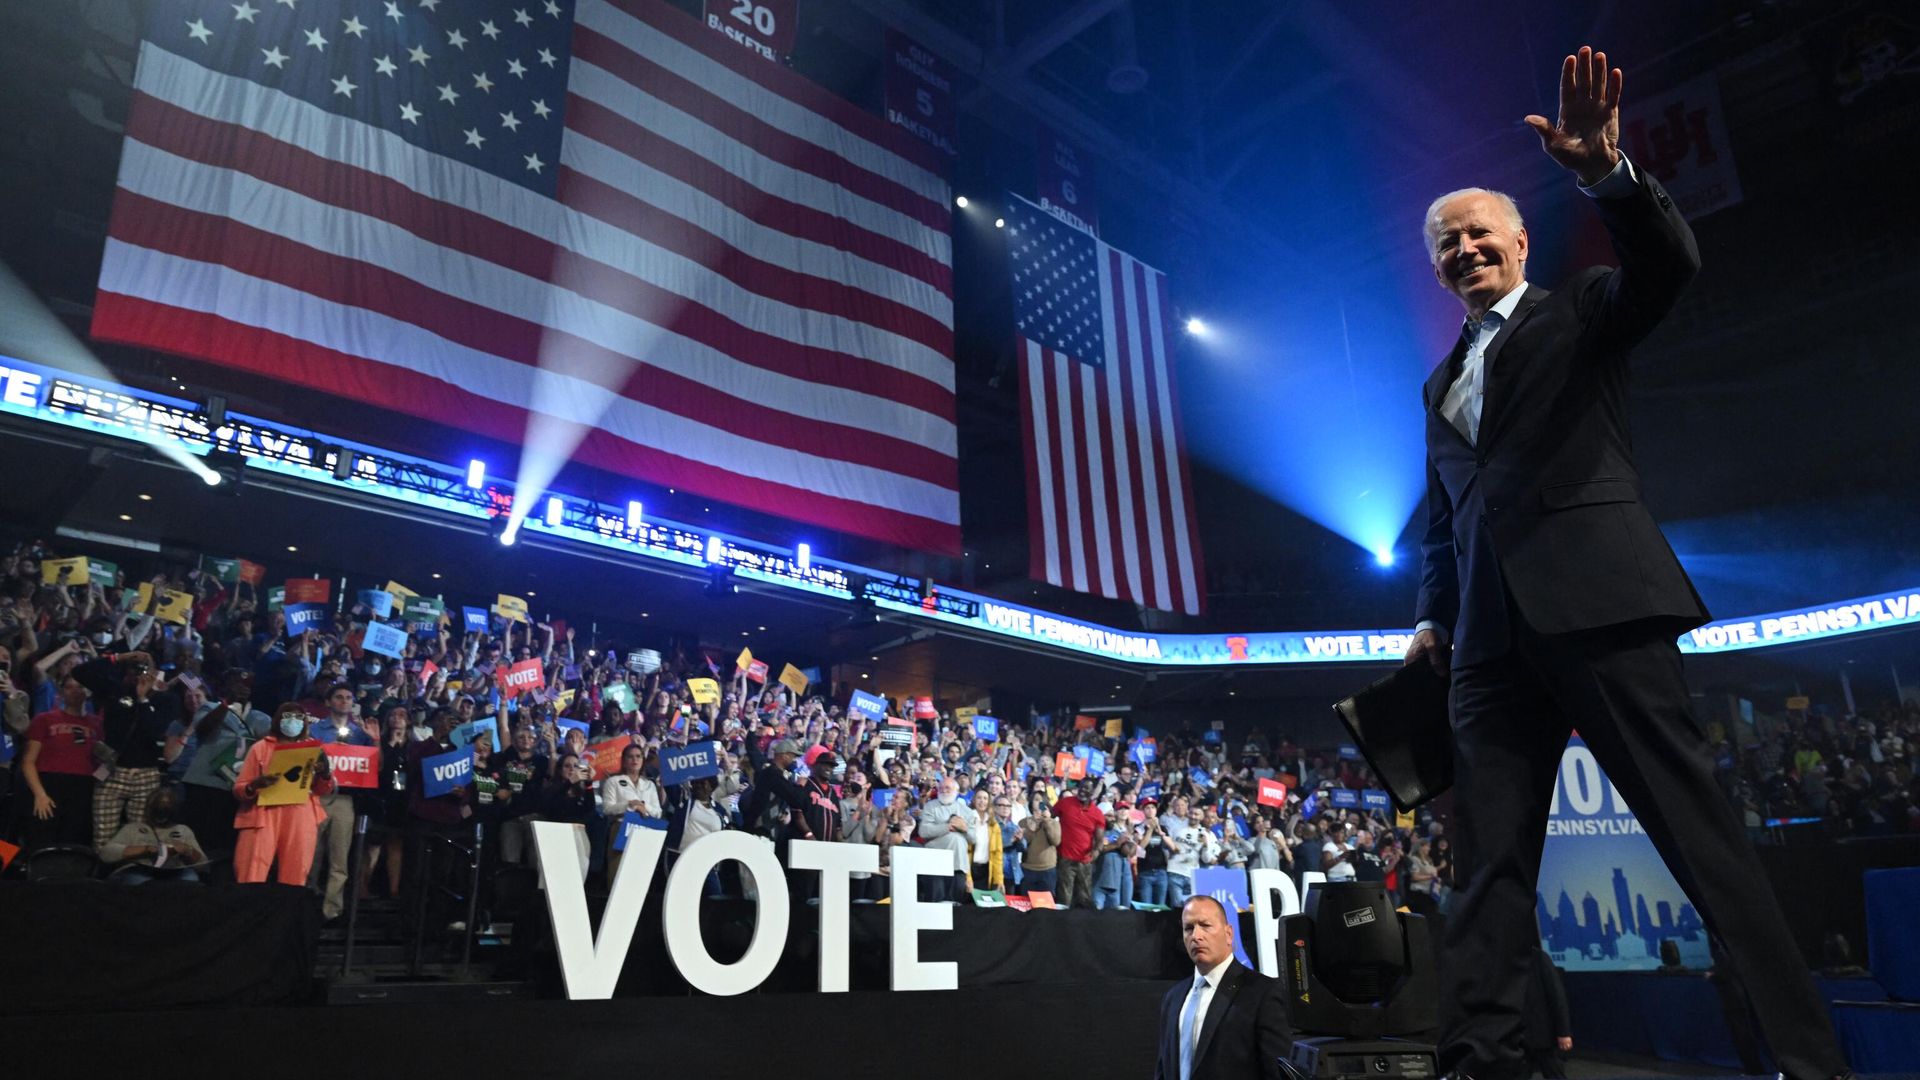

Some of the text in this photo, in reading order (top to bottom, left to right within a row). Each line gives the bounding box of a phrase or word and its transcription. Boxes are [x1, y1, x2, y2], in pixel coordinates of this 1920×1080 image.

[730, 0, 776, 36] 20
[916, 88, 934, 117] 5
[291, 609, 323, 624] VOTE!
[984, 603, 1162, 658] VOTE PENNSYLVANIA
[1692, 622, 1757, 648] VOTE
[1304, 635, 1365, 656] VOTE
[505, 668, 538, 687] VOTE!
[856, 696, 881, 714] VOTE!
[977, 719, 995, 735] USA
[329, 755, 370, 774] VOTE!
[433, 757, 471, 782] VOTE!
[667, 751, 709, 772] VOTE!
[1061, 757, 1082, 775] USA
[1262, 786, 1284, 800] VOTE!
[1547, 819, 1646, 836] ENNSYLVA
[531, 820, 958, 1000] VOTE
